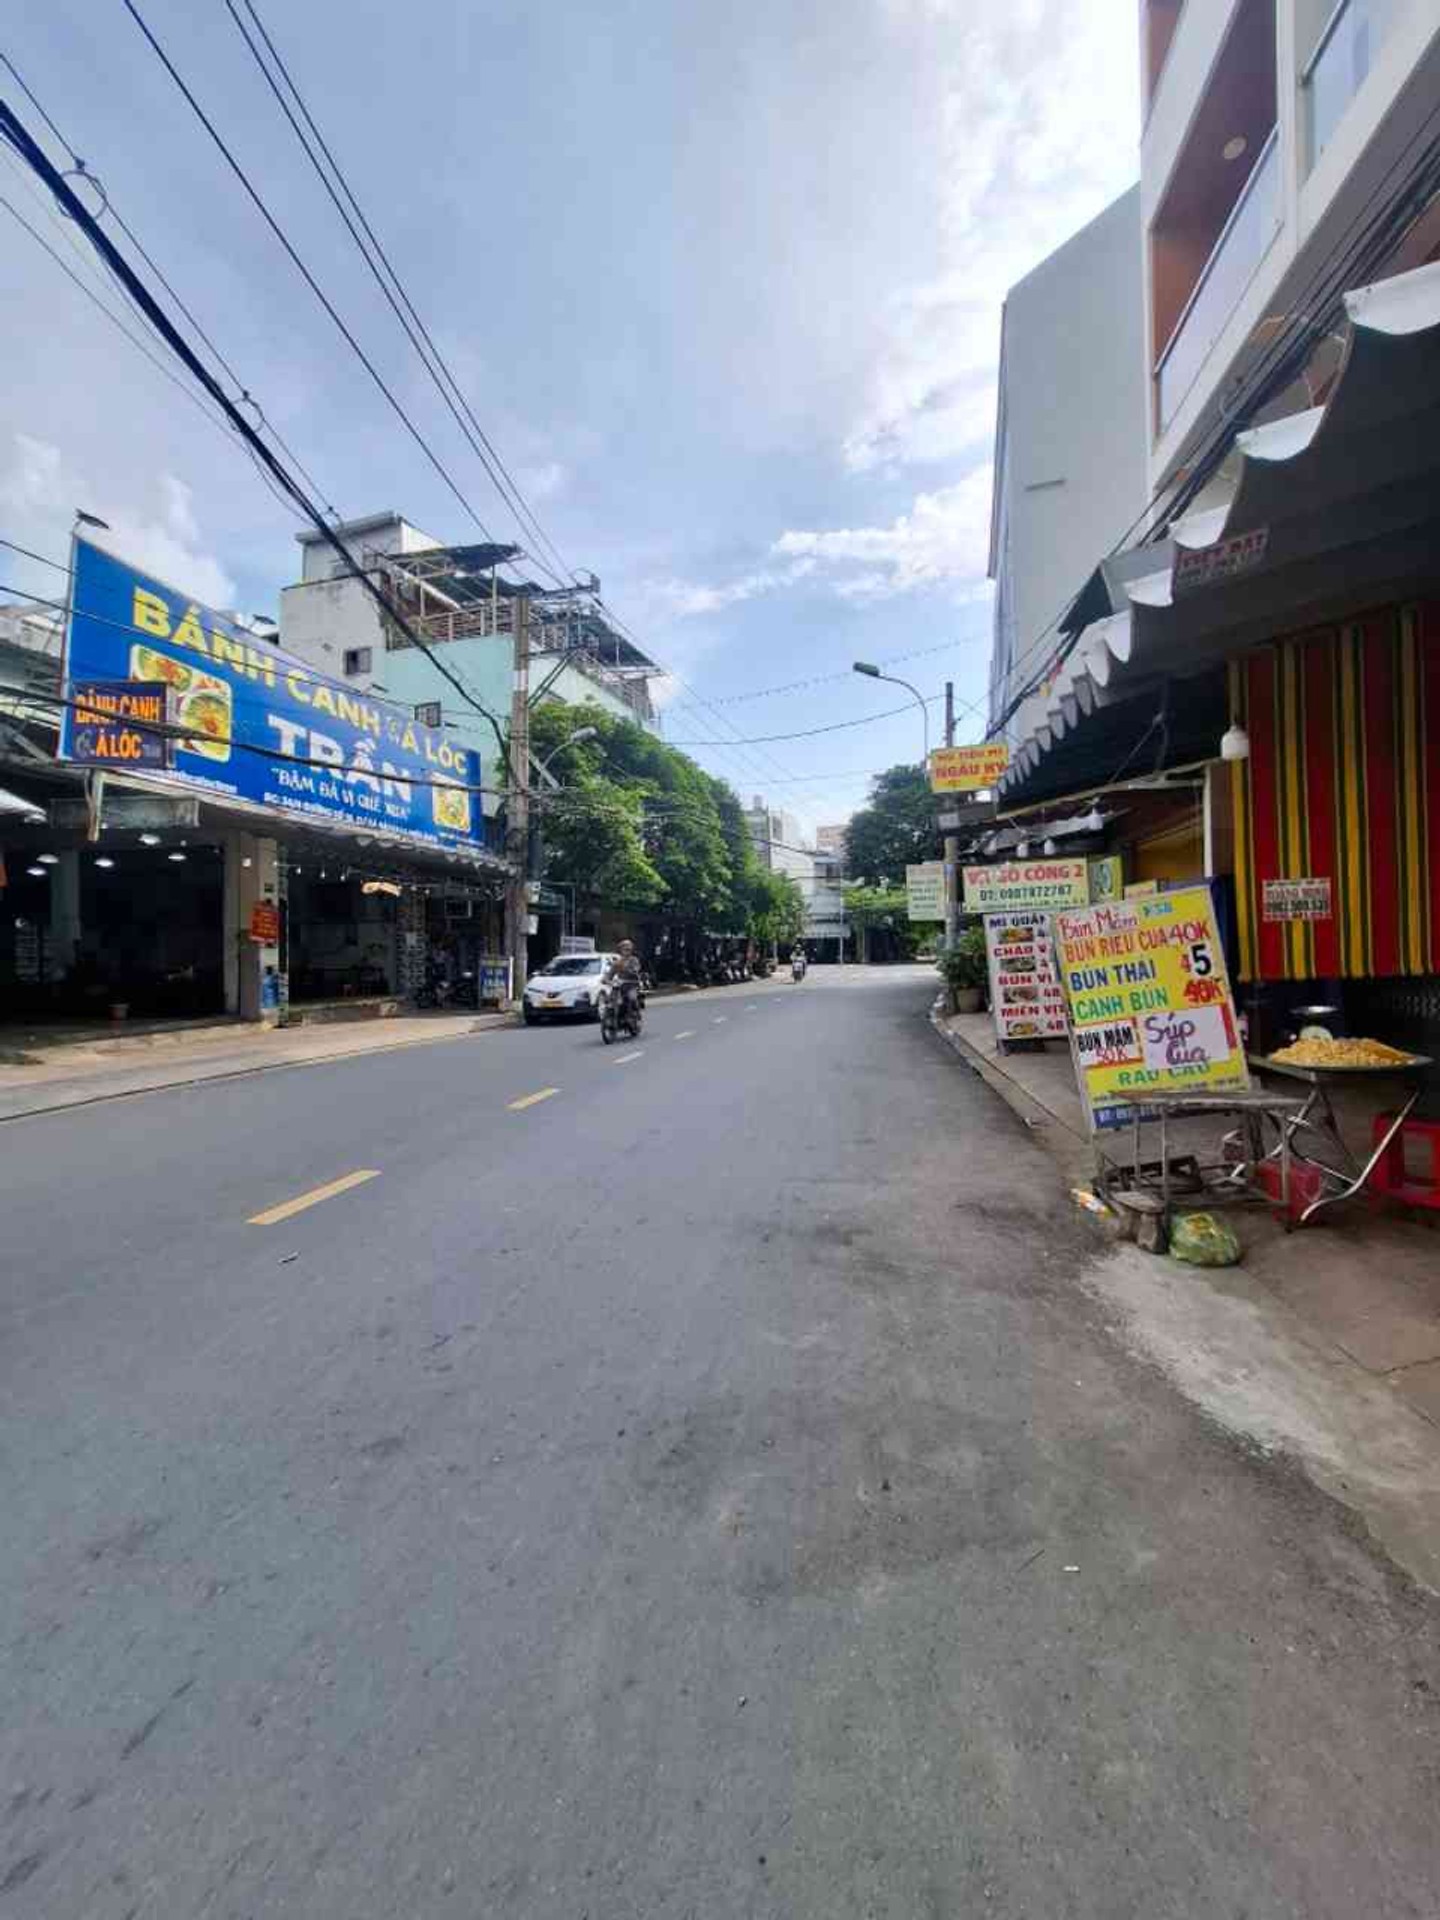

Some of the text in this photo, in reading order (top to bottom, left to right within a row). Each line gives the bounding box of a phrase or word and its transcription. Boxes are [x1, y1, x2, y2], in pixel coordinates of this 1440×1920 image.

[133, 586, 276, 688] BÁNH
[286, 669, 380, 737] CANH
[1024, 863, 1069, 881] CÔNG
[1074, 864, 1084, 878] 2
[1139, 928, 1168, 952] CUA
[1070, 963, 1108, 992] BÚN
[1075, 994, 1125, 1020] CANH
[1129, 983, 1169, 1012] BÚN
[1144, 1011, 1196, 1047] Súp
